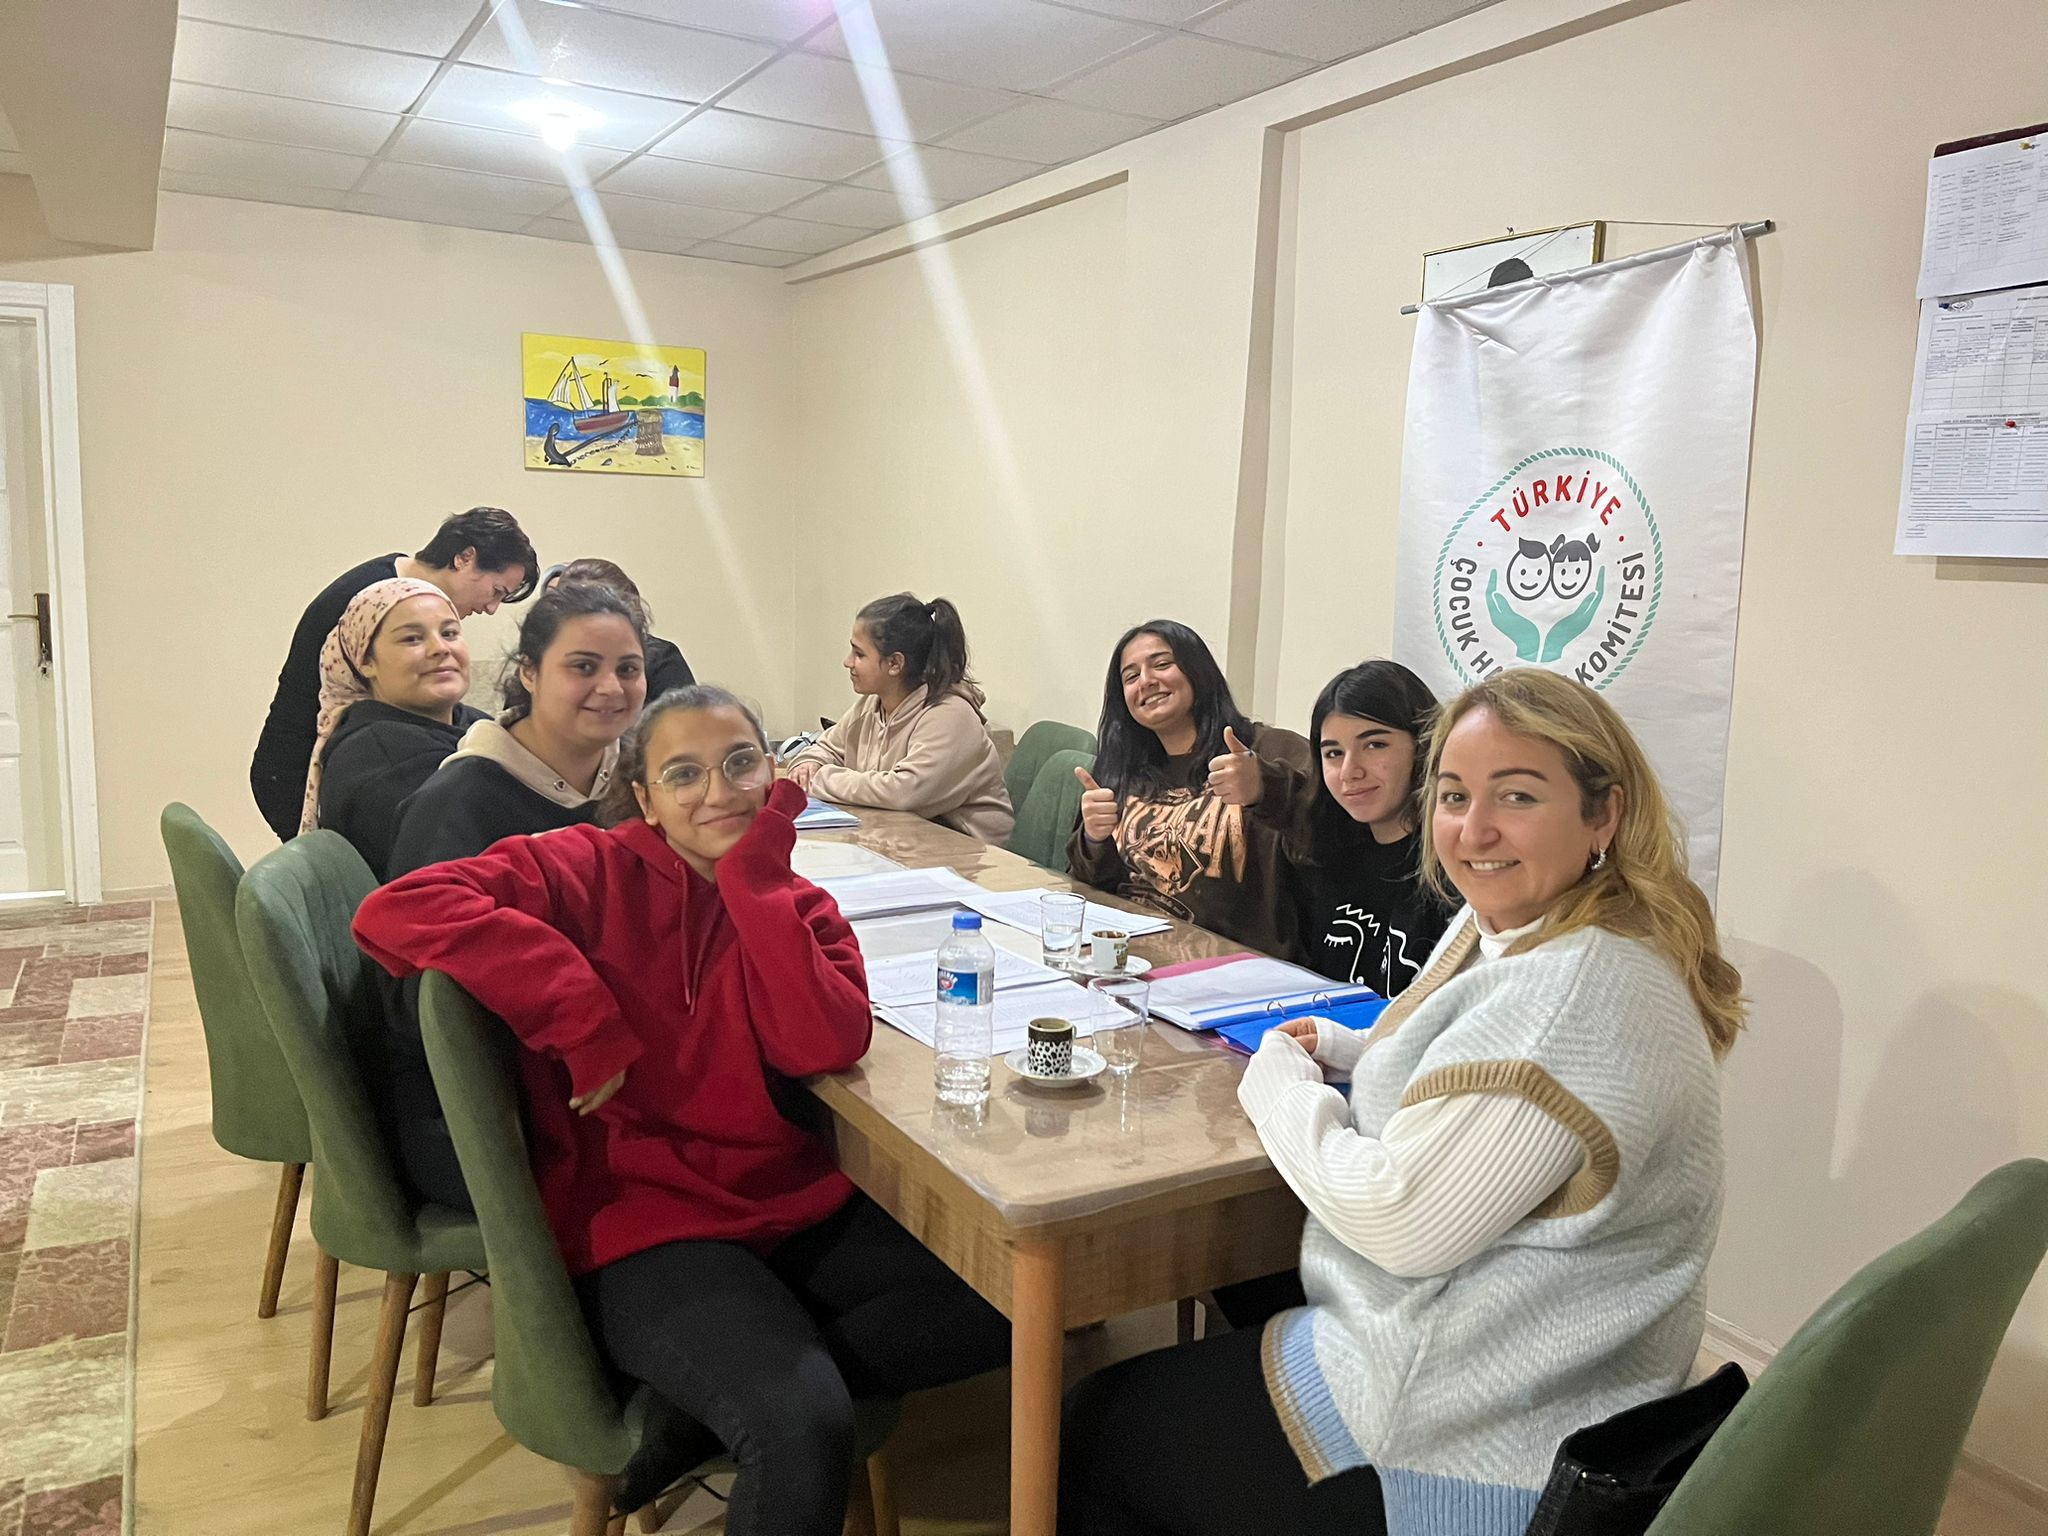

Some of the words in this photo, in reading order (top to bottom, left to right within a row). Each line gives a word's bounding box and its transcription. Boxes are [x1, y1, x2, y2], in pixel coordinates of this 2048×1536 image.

[1490, 470, 1621, 531] TÜRKİYE
[1450, 558, 1479, 651] ÇOCUK
[1575, 552, 1645, 686] KOMİTESİ
